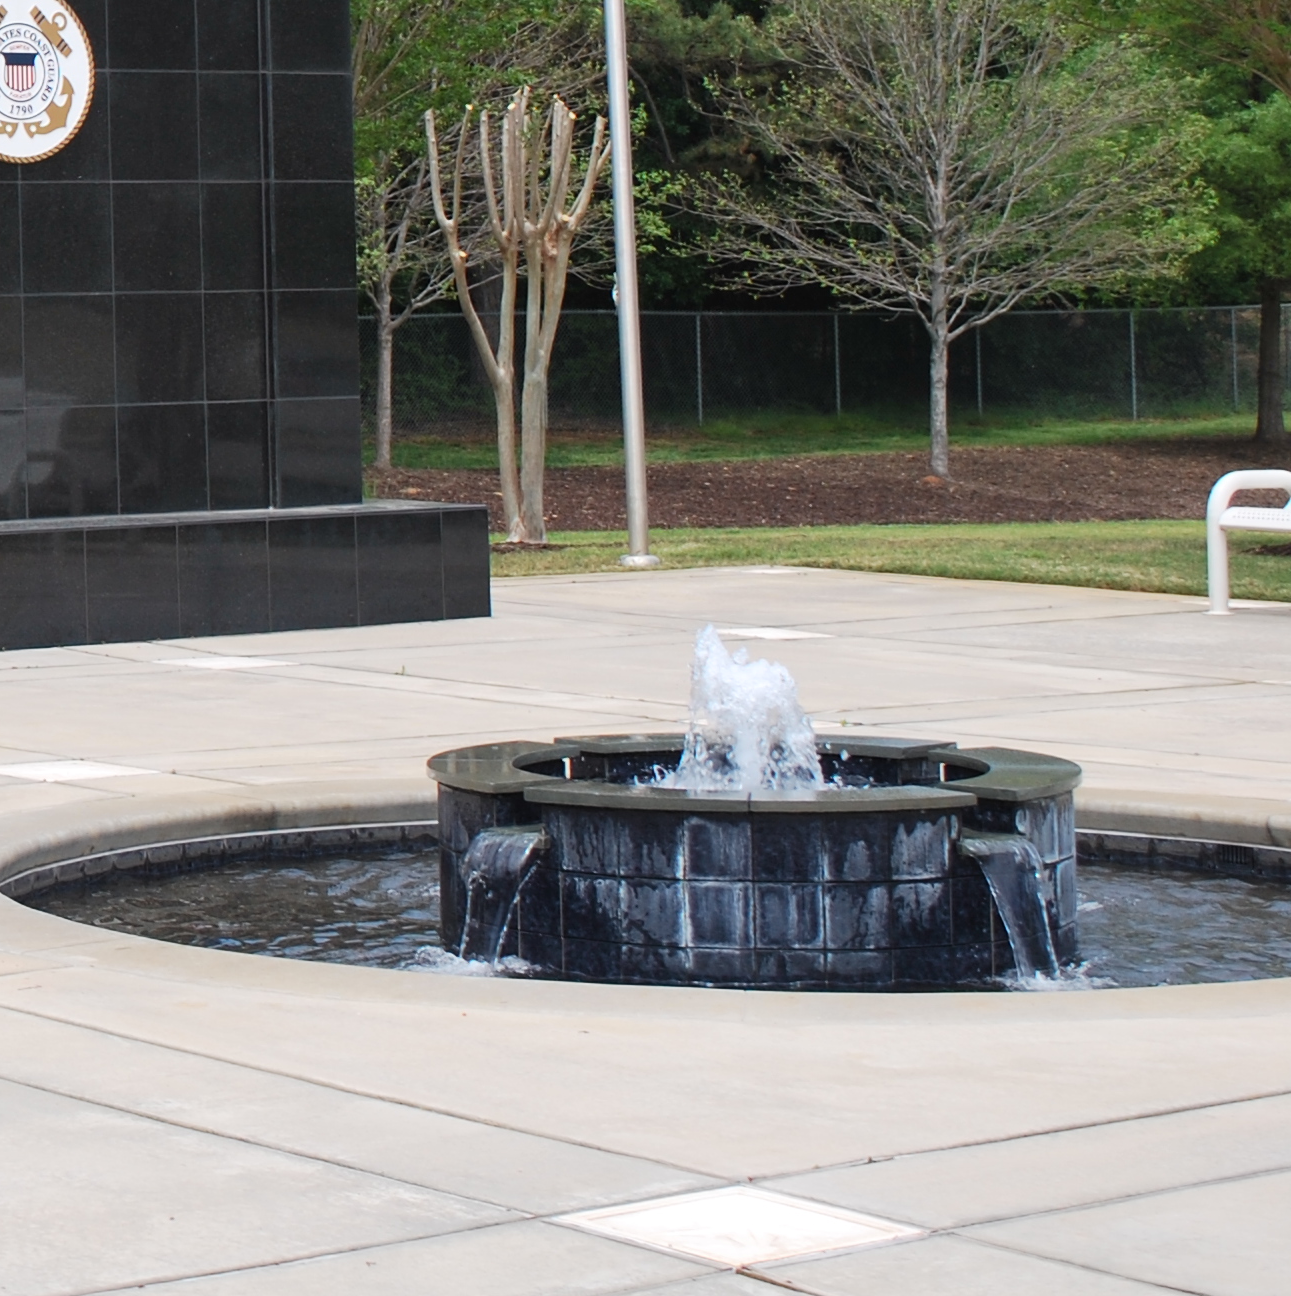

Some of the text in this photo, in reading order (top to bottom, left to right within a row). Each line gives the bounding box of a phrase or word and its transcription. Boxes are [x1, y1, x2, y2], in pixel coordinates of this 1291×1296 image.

[23, 30, 52, 59] COAST
[41, 59, 55, 102] GUARD
[10, 104, 33, 115] 1790
